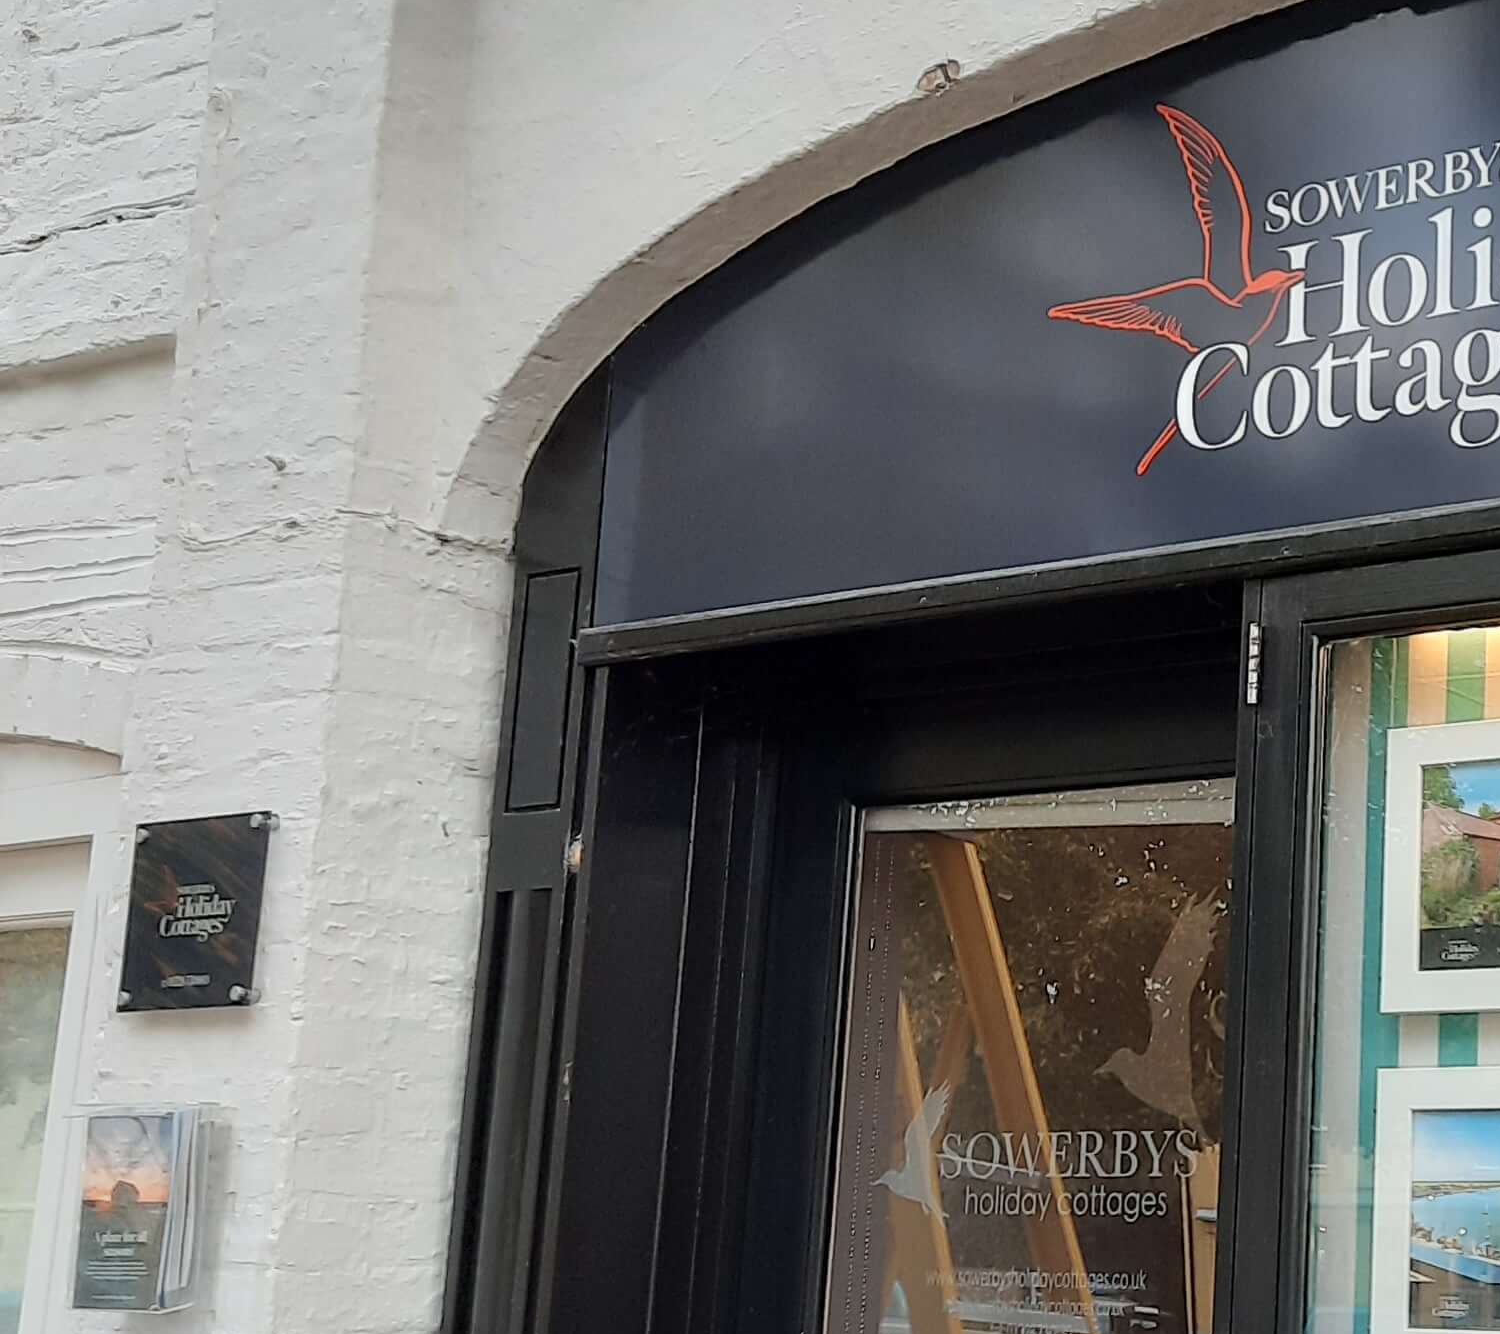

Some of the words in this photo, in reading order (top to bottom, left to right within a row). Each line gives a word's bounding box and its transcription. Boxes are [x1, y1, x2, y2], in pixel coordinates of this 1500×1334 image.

[940, 1129, 1199, 1180] SOWERBYS
[965, 1185, 1051, 1221] holiday
[1058, 1187, 1168, 1223] cottages
